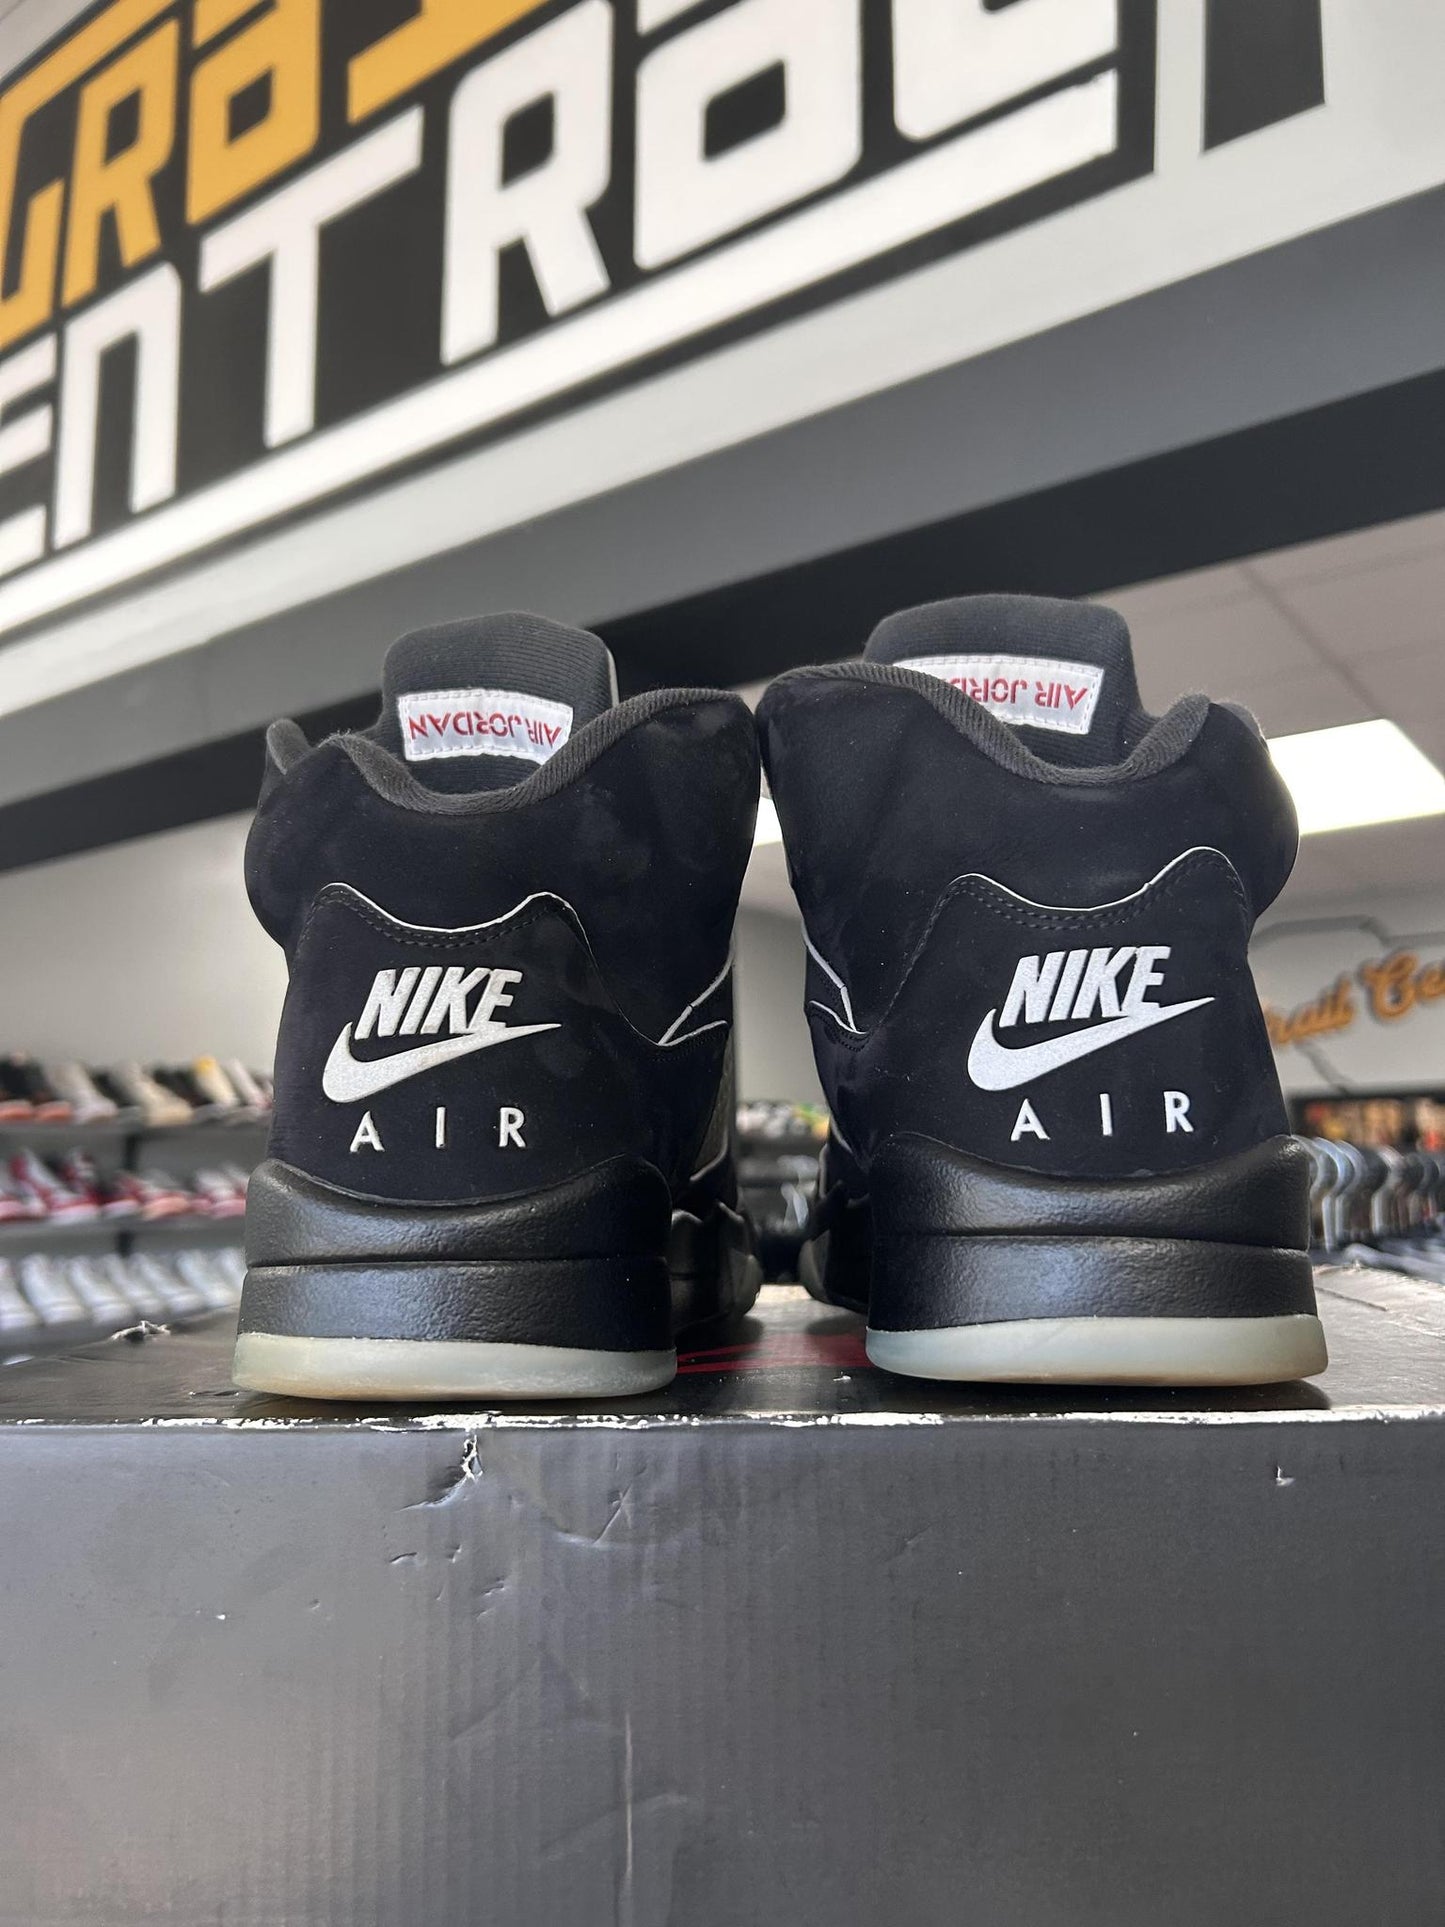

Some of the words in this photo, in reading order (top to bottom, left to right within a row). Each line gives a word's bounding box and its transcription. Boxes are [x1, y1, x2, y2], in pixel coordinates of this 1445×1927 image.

[1035, 681, 1088, 711] AIR
[408, 710, 522, 741] JORDAN
[525, 717, 563, 748] AIR
[354, 966, 523, 1040] NIKE
[999, 946, 1172, 1028] NIKE
[350, 1106, 527, 1152] AIR
[1010, 1091, 1194, 1141] AIR
